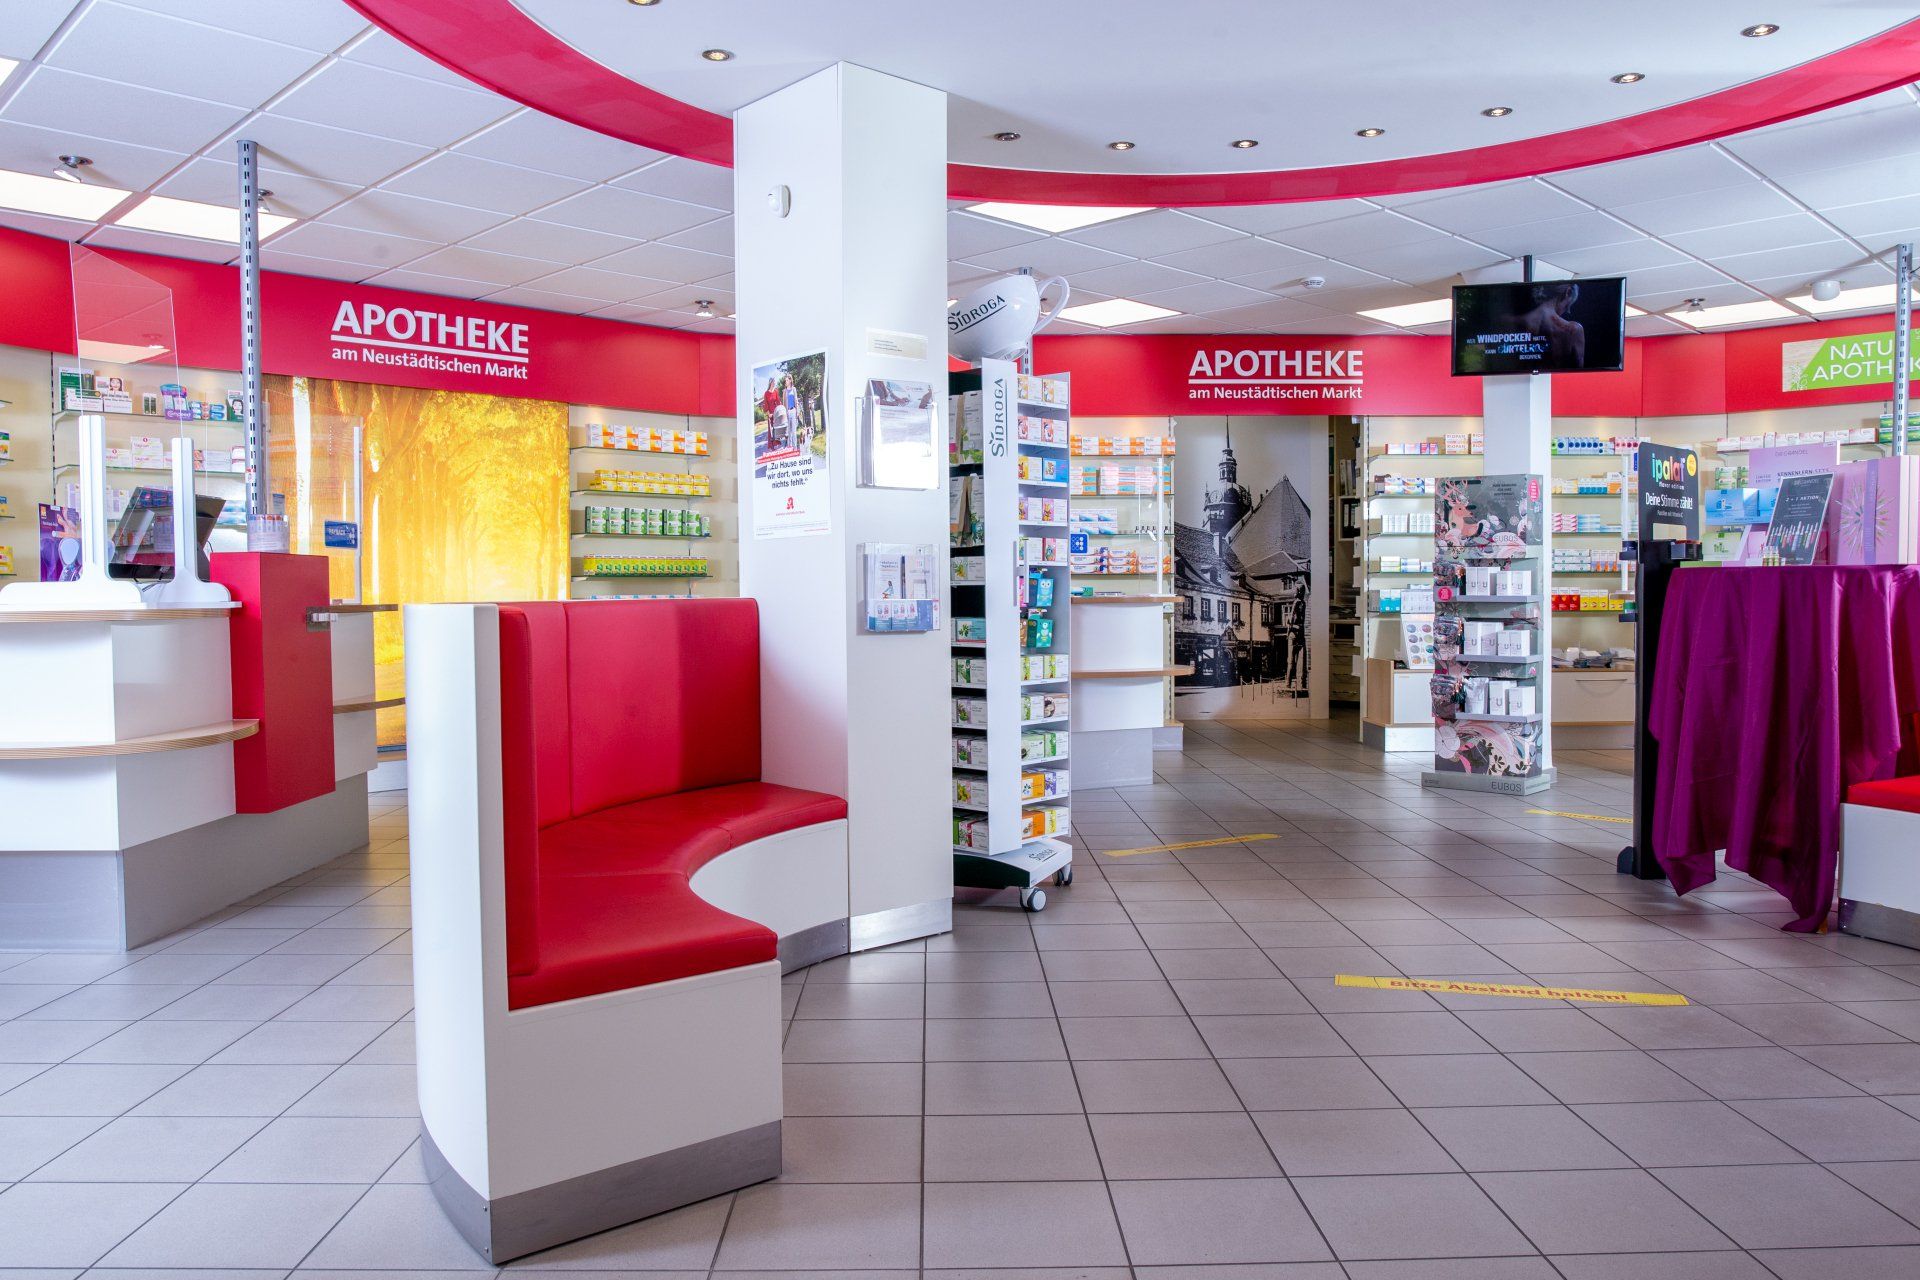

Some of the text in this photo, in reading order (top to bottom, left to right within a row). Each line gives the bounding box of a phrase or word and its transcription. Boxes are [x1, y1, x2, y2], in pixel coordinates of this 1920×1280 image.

[948, 295, 1006, 331] SIDROGA
[331, 300, 529, 354] APOTHEKE
[1477, 332, 1532, 344] WINDPOCKEN
[1830, 339, 1894, 360] NATU
[332, 347, 528, 380] am Neustädtischen Markt
[1188, 350, 1364, 376] APOTHEKE
[1189, 386, 1363, 400] am Neustädtischen Markt
[991, 378, 1005, 457] SIDROGA
[780, 460, 797, 469] Hause
[799, 457, 812, 466] sind
[802, 467, 813, 475] uns
[772, 480, 789, 489] nichts
[1645, 492, 1693, 509] Deine Stimme zählt!
[1491, 781, 1522, 792] EUBOS
[1390, 981, 1628, 1001] Bitte Abstand halten!
